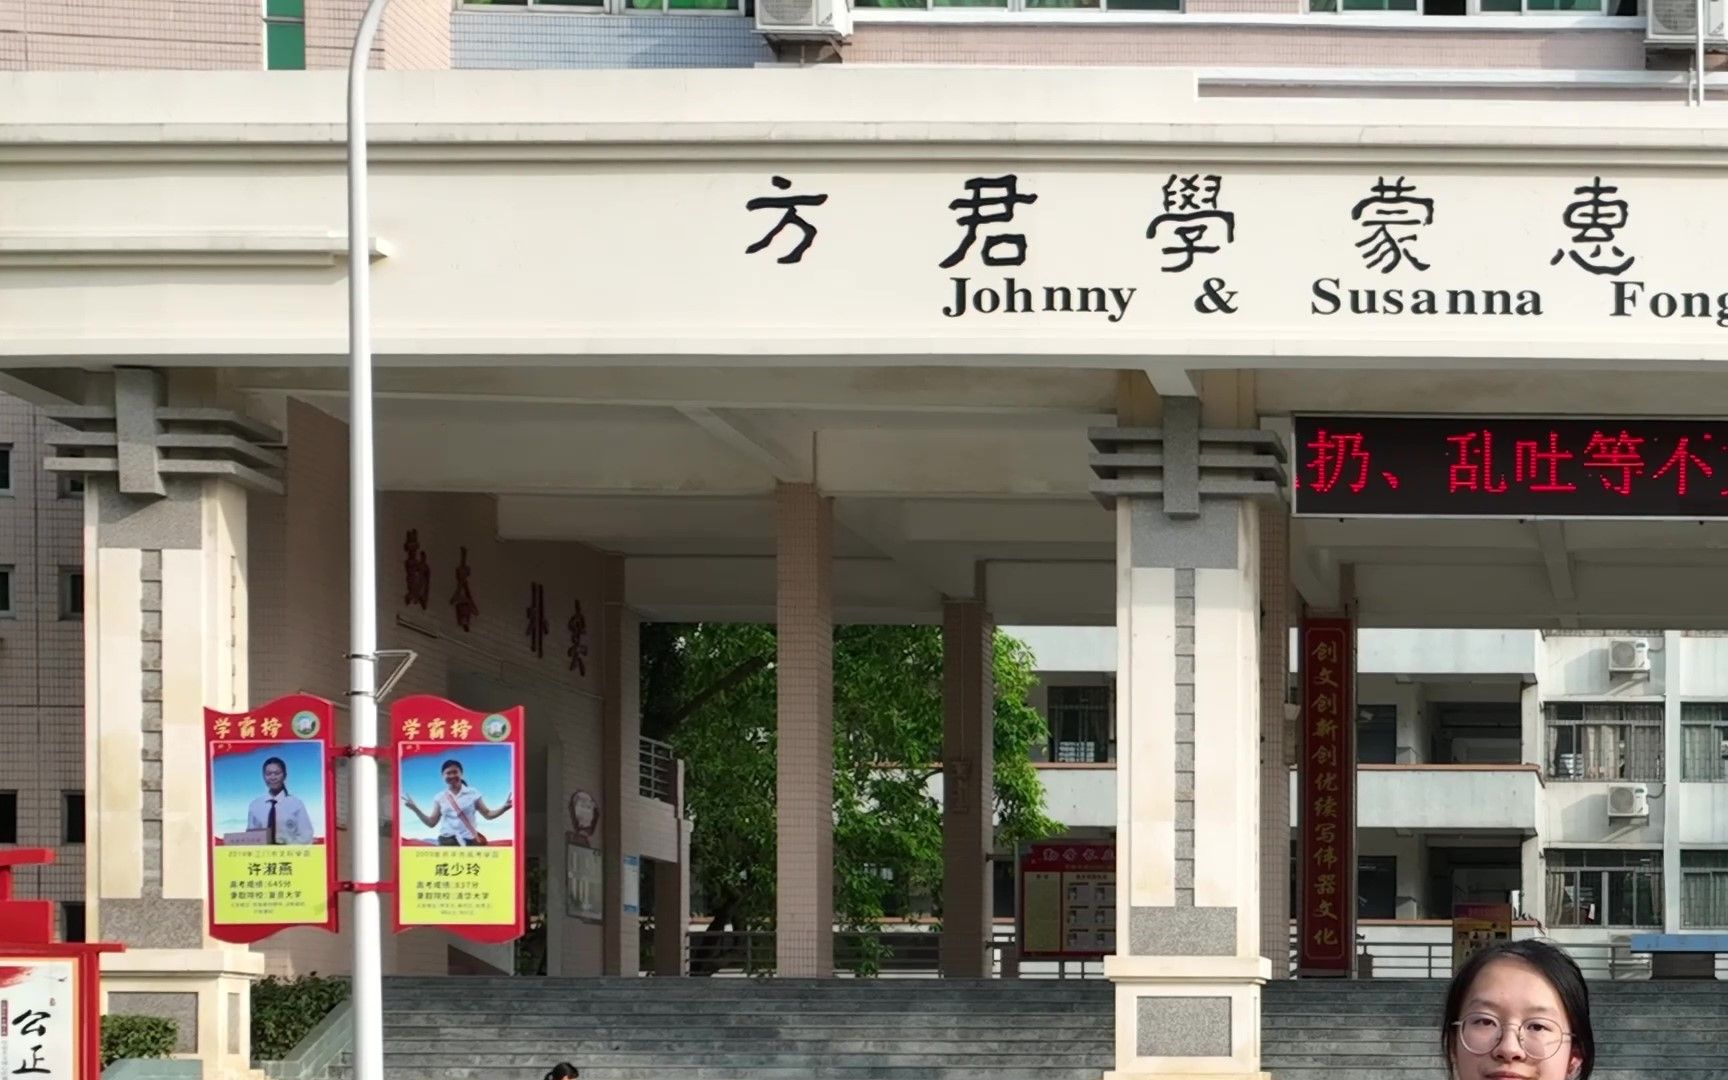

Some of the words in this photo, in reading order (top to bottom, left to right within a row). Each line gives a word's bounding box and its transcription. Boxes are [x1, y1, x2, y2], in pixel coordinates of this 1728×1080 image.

[942, 277, 1137, 323] Johnny
[1194, 277, 1238, 314] &
[1311, 278, 1543, 316] Susanna
[213, 716, 283, 740] 学霸榜
[402, 717, 473, 740] 学霸榜
[12, 1009, 51, 1074] 公正
